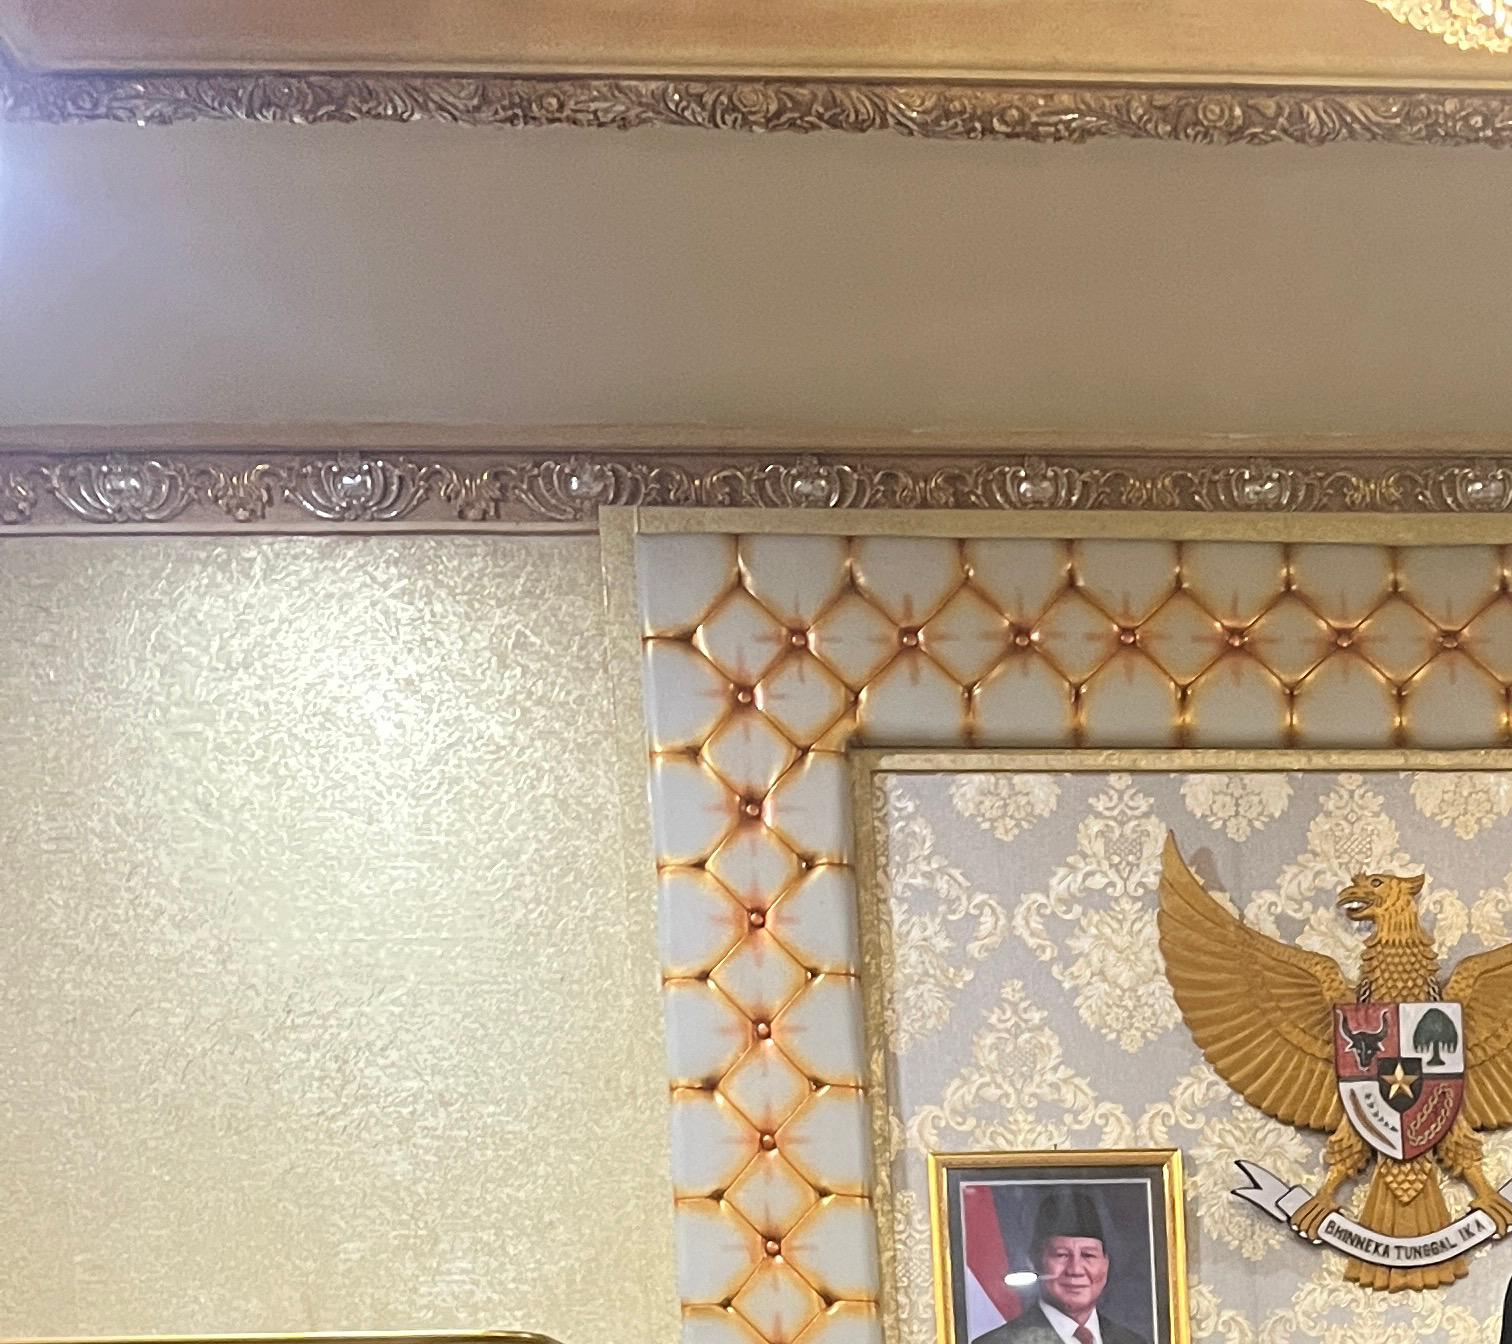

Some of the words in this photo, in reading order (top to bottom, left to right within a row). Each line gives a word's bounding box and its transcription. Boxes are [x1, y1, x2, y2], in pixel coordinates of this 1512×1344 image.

[1324, 1219, 1391, 1259] BHINNEKA
[1394, 1236, 1458, 1261] TUNGGAL
[1458, 1218, 1487, 1242] IKA
